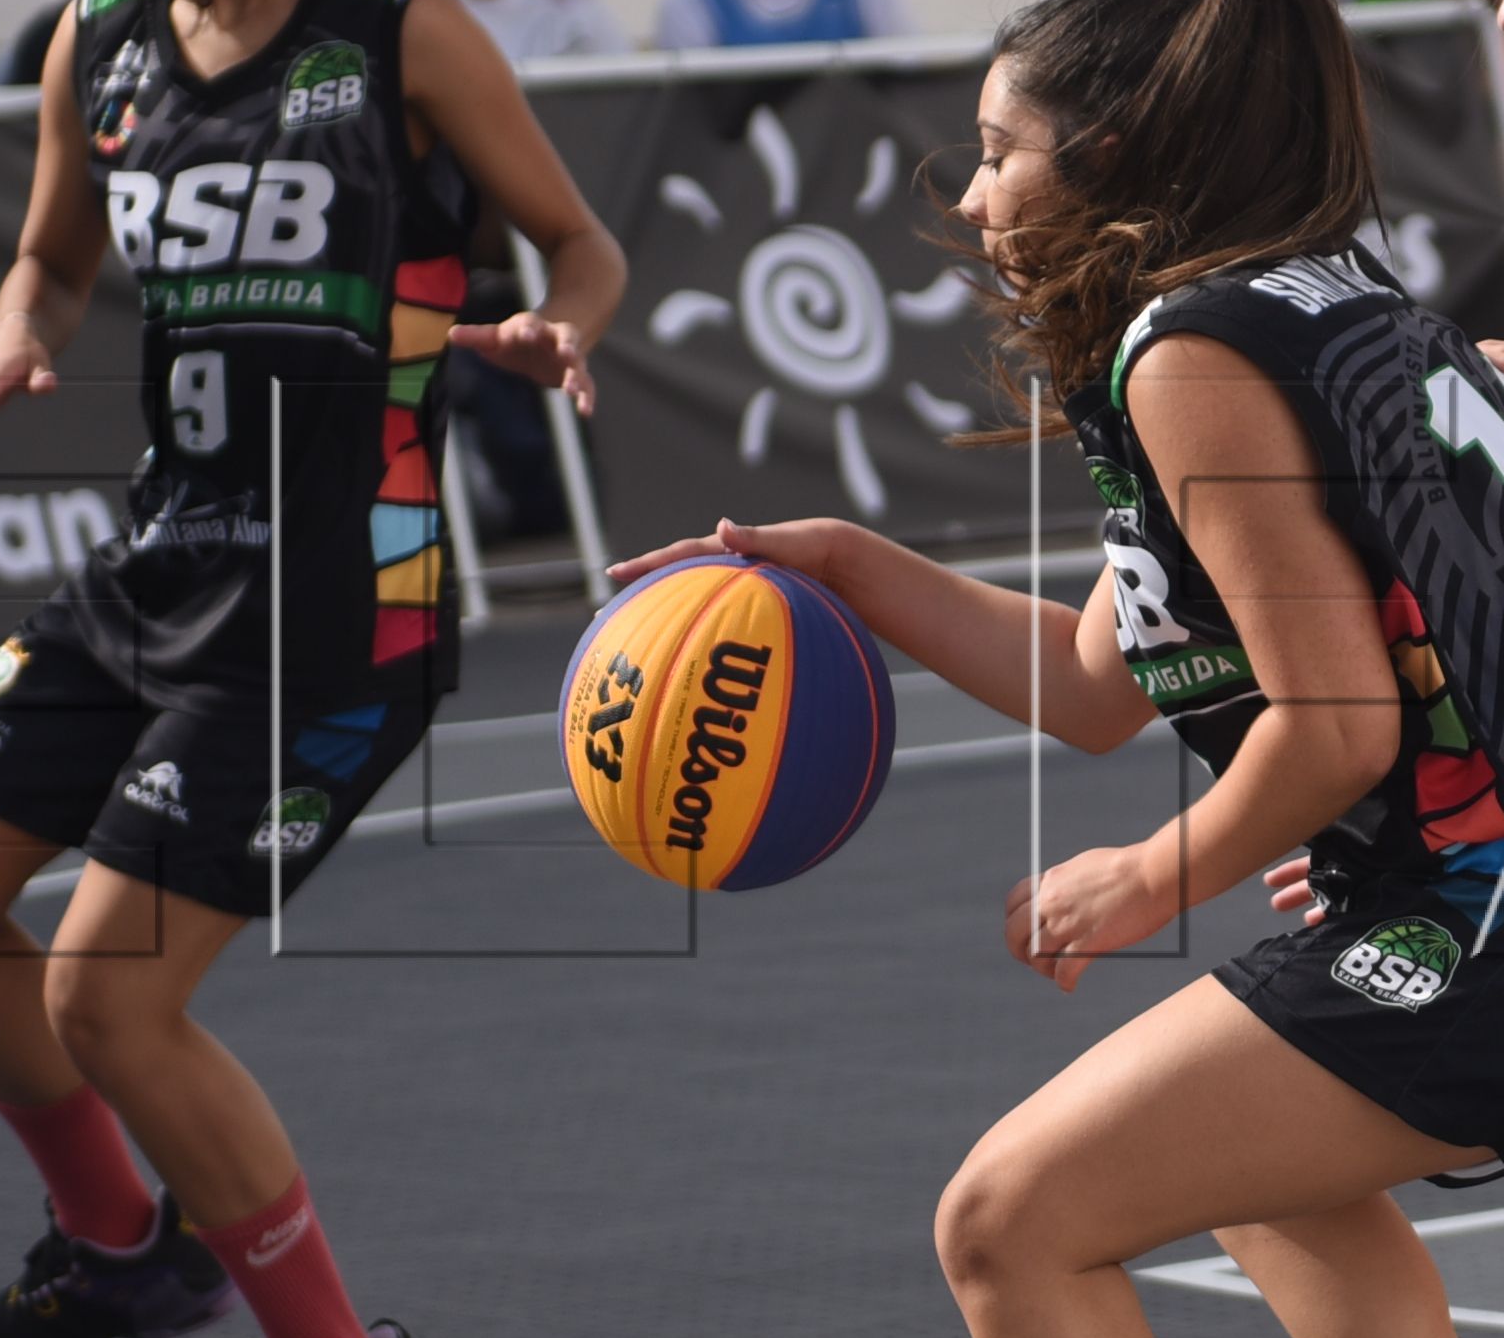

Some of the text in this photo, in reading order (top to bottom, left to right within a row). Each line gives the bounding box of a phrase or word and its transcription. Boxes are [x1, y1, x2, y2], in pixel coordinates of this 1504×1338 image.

[285, 74, 363, 120] BSB
[107, 159, 336, 271] BSB
[190, 274, 325, 311] BRÍGIDA
[169, 349, 230, 454] 9
[665, 639, 773, 853] Wilson
[1337, 970, 1371, 991] SANTA
[1339, 942, 1443, 1002] BSB
